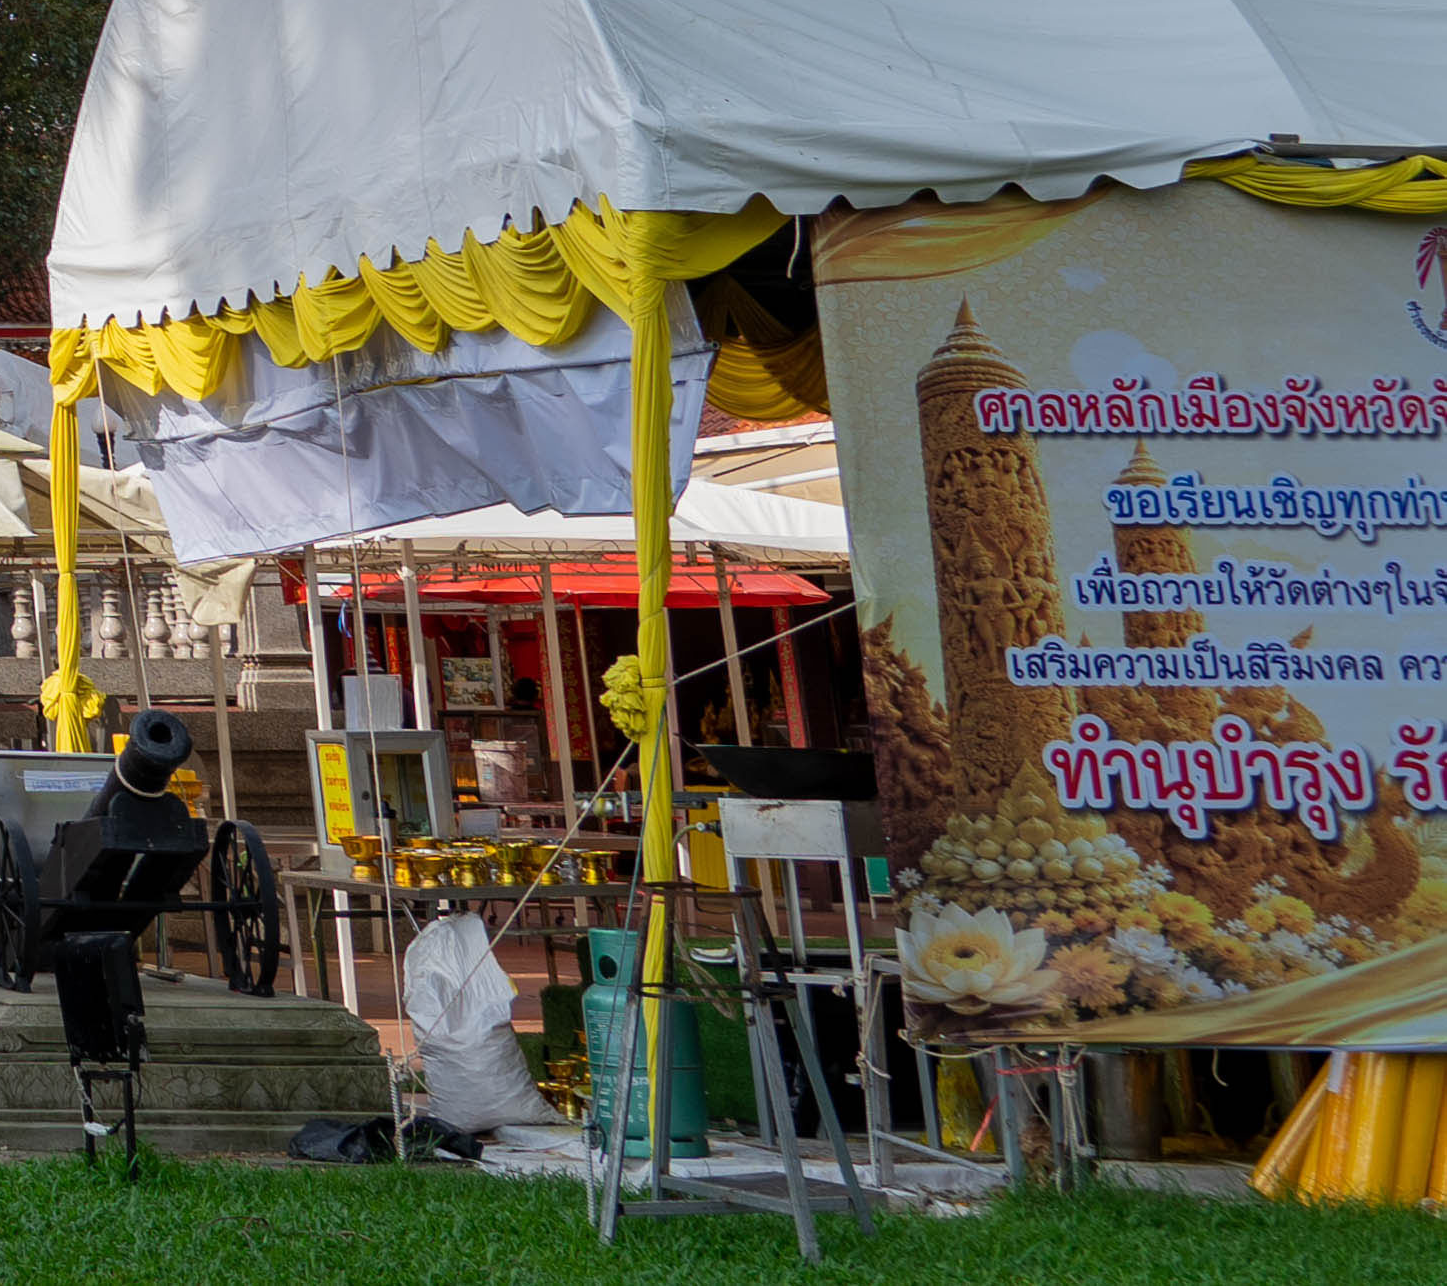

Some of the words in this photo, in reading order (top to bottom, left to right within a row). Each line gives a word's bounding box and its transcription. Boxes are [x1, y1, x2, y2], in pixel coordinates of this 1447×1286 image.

[1108, 474, 1447, 535] ขอเรียนเชิญทุกท่า
[1011, 638, 1383, 681] เสริมความเป็นสิริมงคล
[1051, 722, 1364, 831] ทำนุบำรุง
